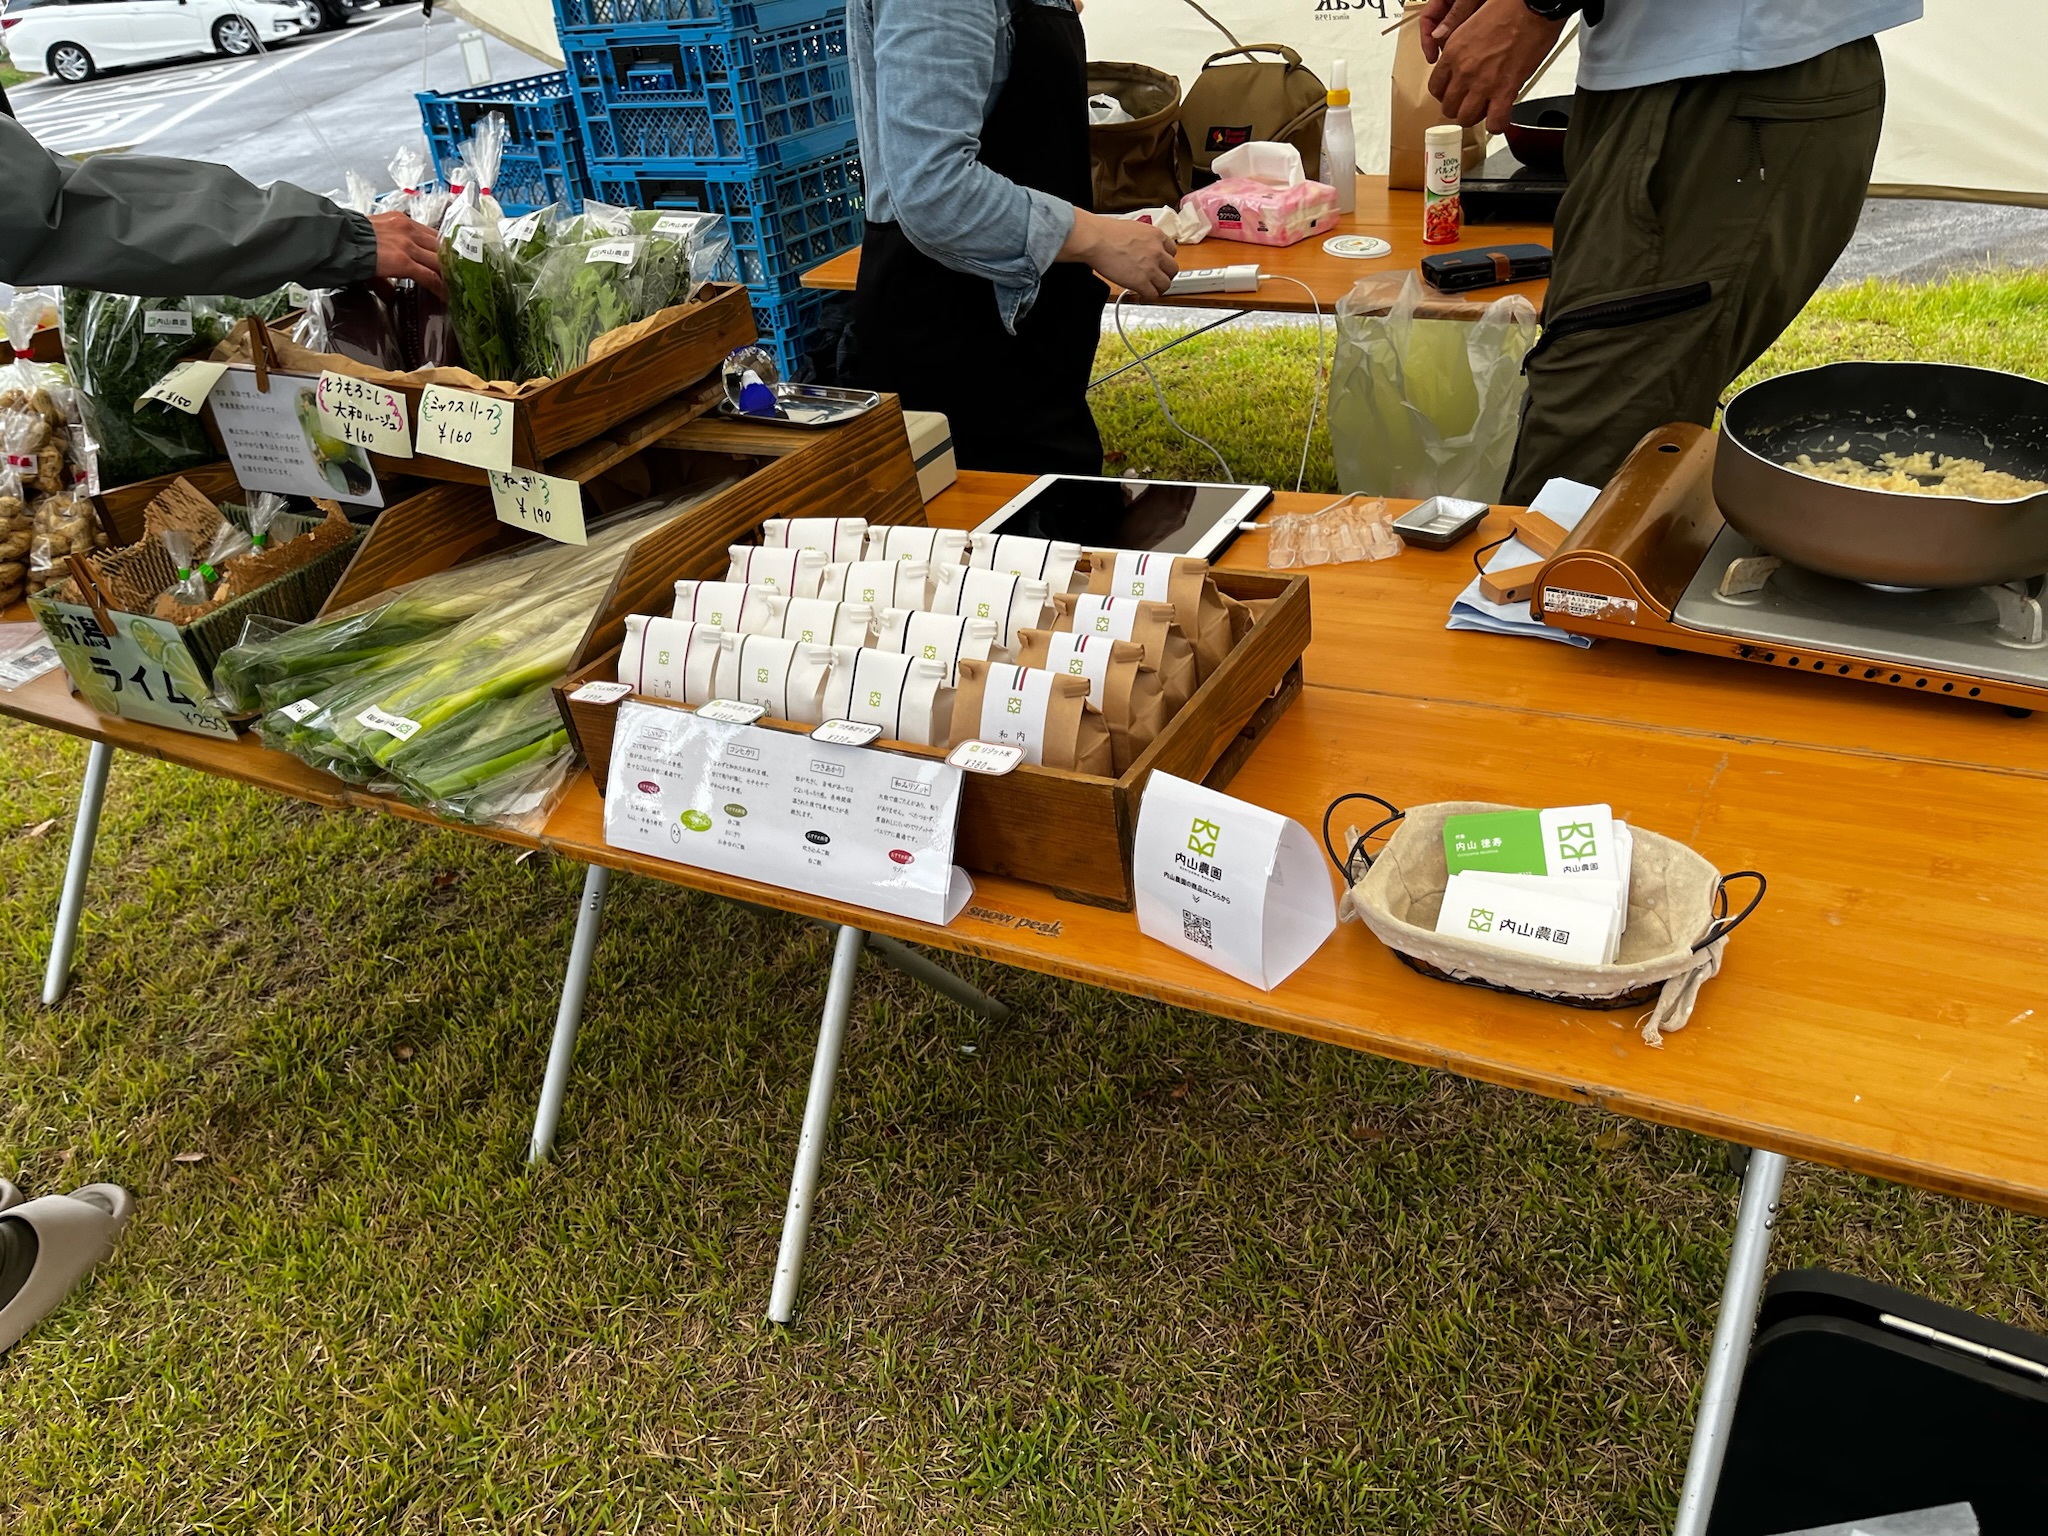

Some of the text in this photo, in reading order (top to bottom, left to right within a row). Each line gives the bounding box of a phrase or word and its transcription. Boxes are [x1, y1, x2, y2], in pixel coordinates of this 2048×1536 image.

[599, 249, 630, 258] 内山農園
[156, 318, 188, 327] 内山農園
[324, 377, 381, 406] とうもろこし
[333, 401, 398, 431] 大和ルージュ
[344, 422, 375, 444] ¥160
[438, 421, 472, 444] ¥160
[502, 472, 536, 492] ねぎ
[39, 610, 112, 650] 新潟
[89, 656, 197, 708] ライム
[653, 679, 659, 698] こし
[664, 680, 672, 698] 内山
[179, 709, 228, 733] ¥250
[729, 745, 757, 758] コシヒカリ
[814, 762, 842, 775] つきあかり
[964, 758, 987, 770] ¥380
[894, 780, 929, 795] 和みリゾット
[1455, 841, 1477, 852] 内山
[1174, 852, 1222, 881] 内山農園
[1563, 862, 1599, 873] 内山農園
[967, 906, 1063, 935] snow peak
[1499, 918, 1570, 945] 内山農園
